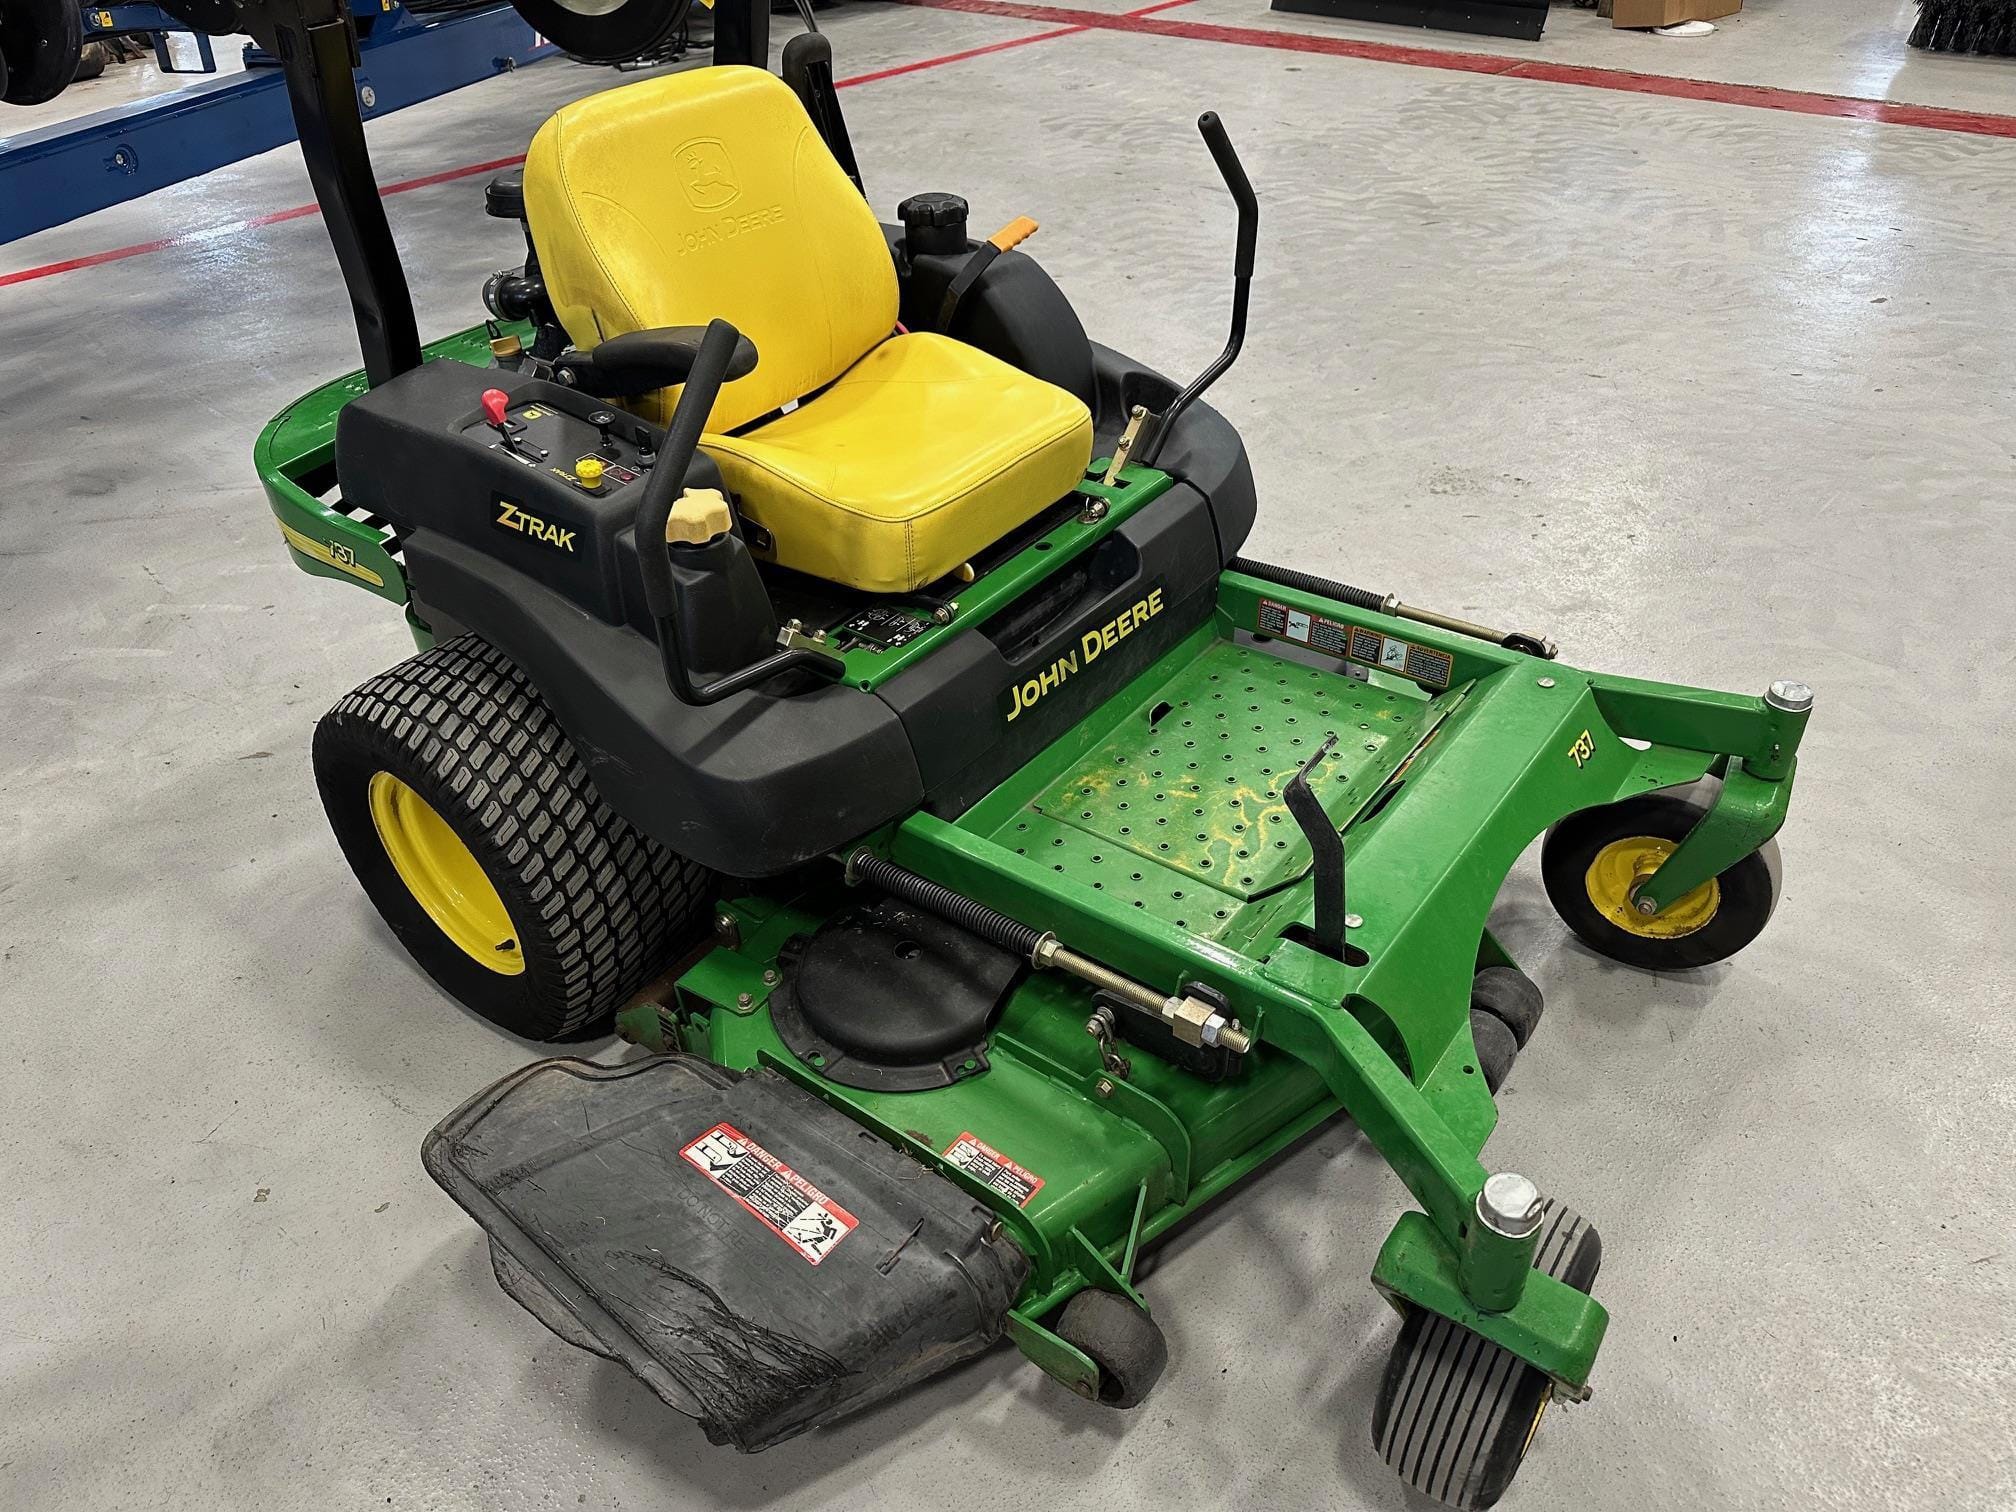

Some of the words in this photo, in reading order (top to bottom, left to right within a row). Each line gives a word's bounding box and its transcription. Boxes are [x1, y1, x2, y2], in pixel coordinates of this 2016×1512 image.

[676, 222, 723, 256] JOHN
[720, 203, 785, 239] DEERE
[496, 501, 577, 552] ZTRAK
[1006, 650, 1079, 722] JOHN
[1081, 587, 1164, 665] DEERE
[1567, 728, 1596, 768] 737
[746, 1142, 782, 1170] DANGER
[790, 1173, 830, 1204] PELIGRO
[977, 1141, 1001, 1160] DANGER
[1012, 1163, 1038, 1184] PELIGRO
